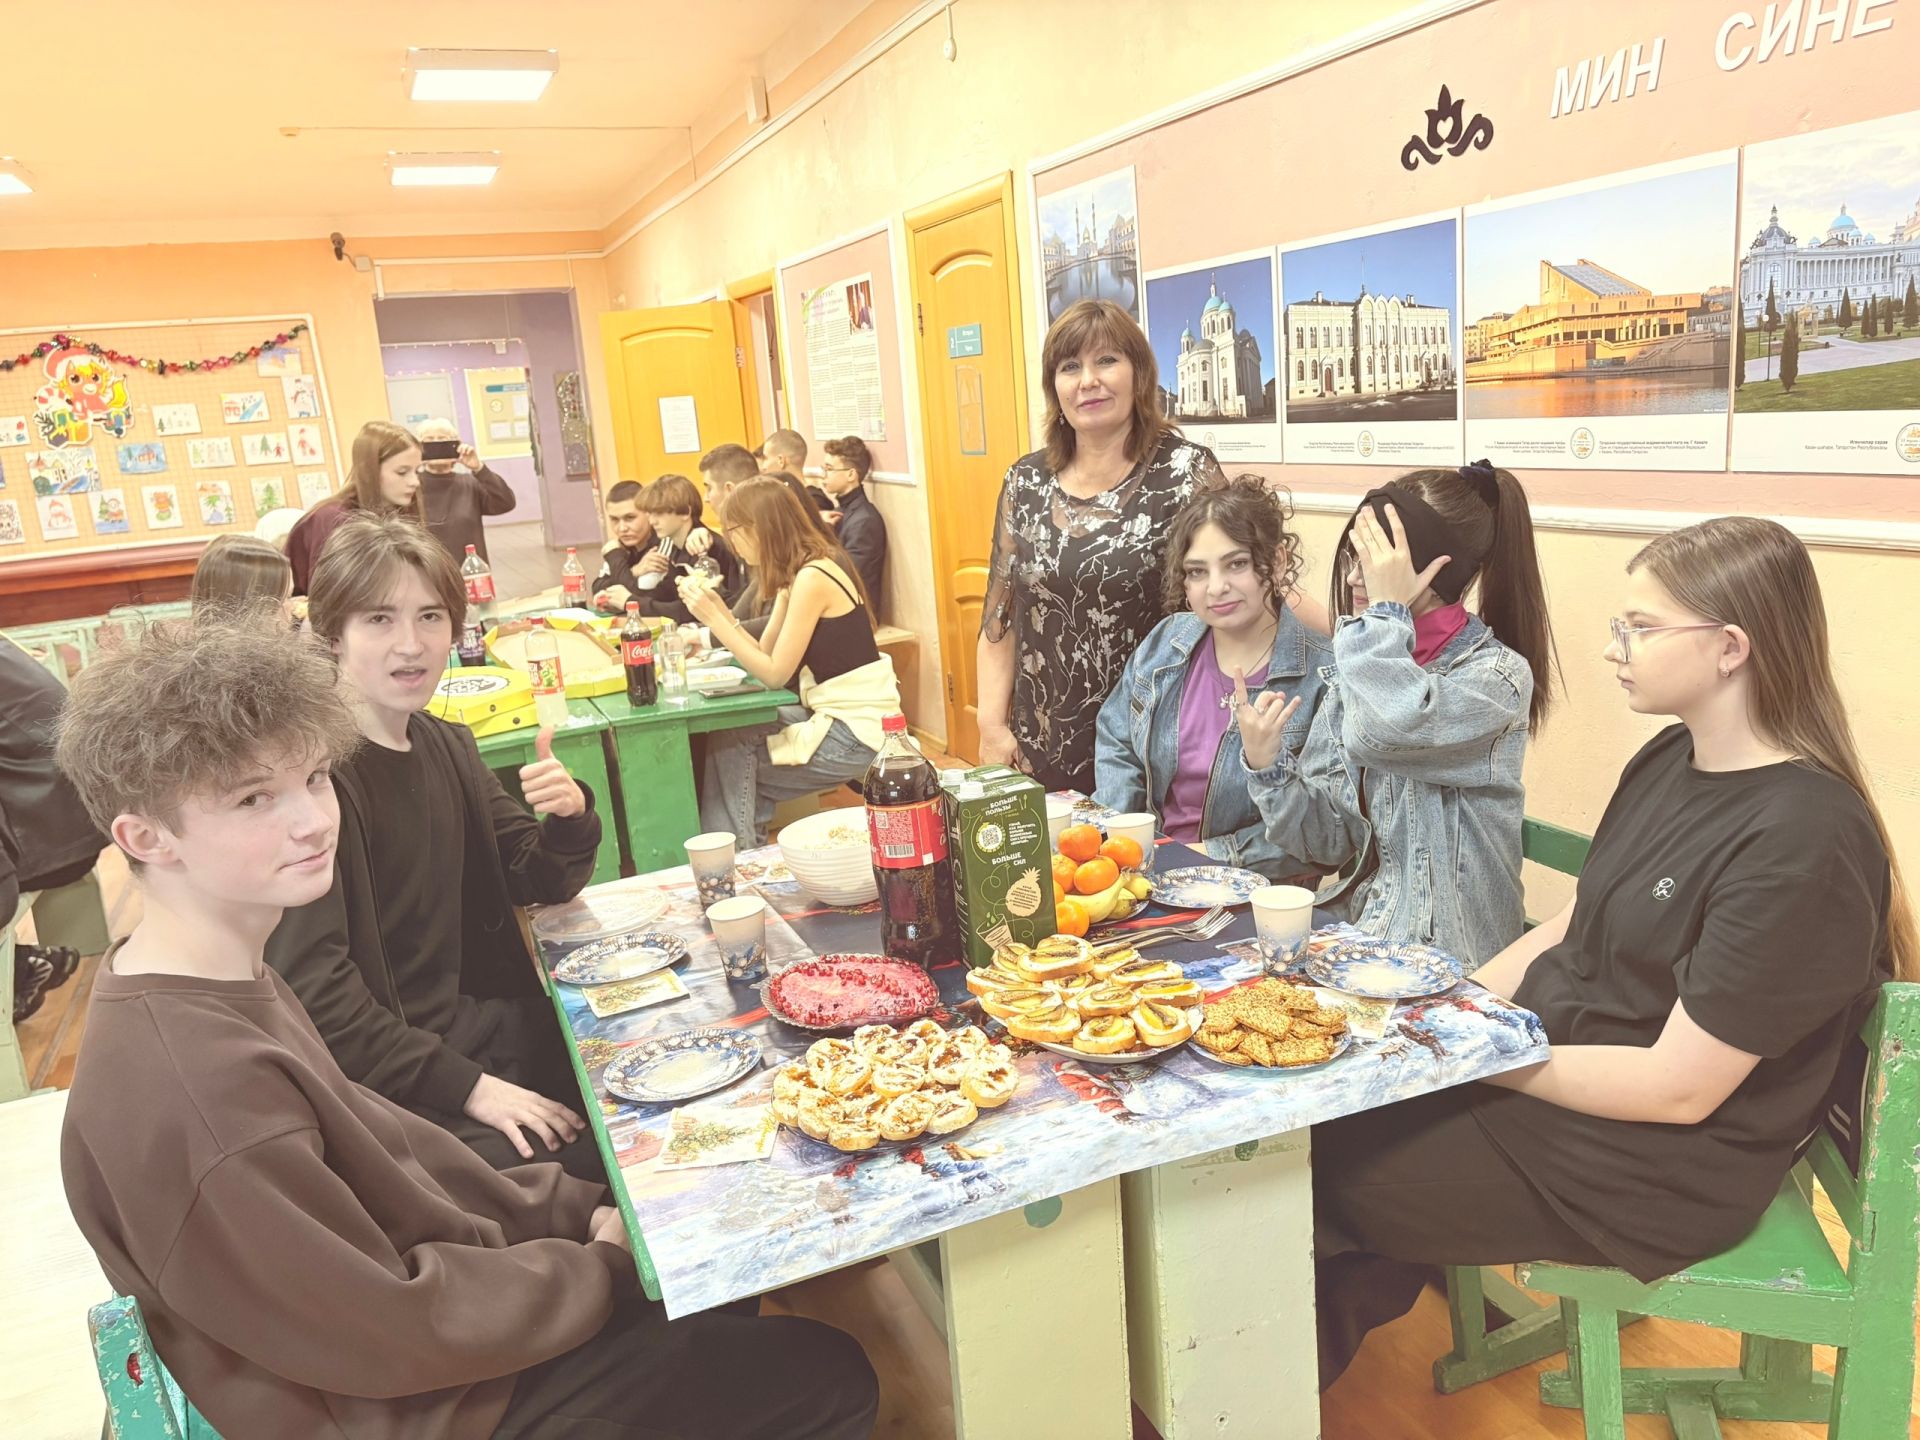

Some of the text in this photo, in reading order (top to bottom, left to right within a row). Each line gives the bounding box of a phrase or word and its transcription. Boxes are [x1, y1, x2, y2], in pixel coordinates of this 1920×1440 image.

[1549, 36, 1666, 119] МИН
[990, 795, 1018, 808] БОЛЬШЕ
[985, 804, 1011, 816] ПОЛЬЗЫ
[992, 852, 1022, 865] БОЛЬШЕ
